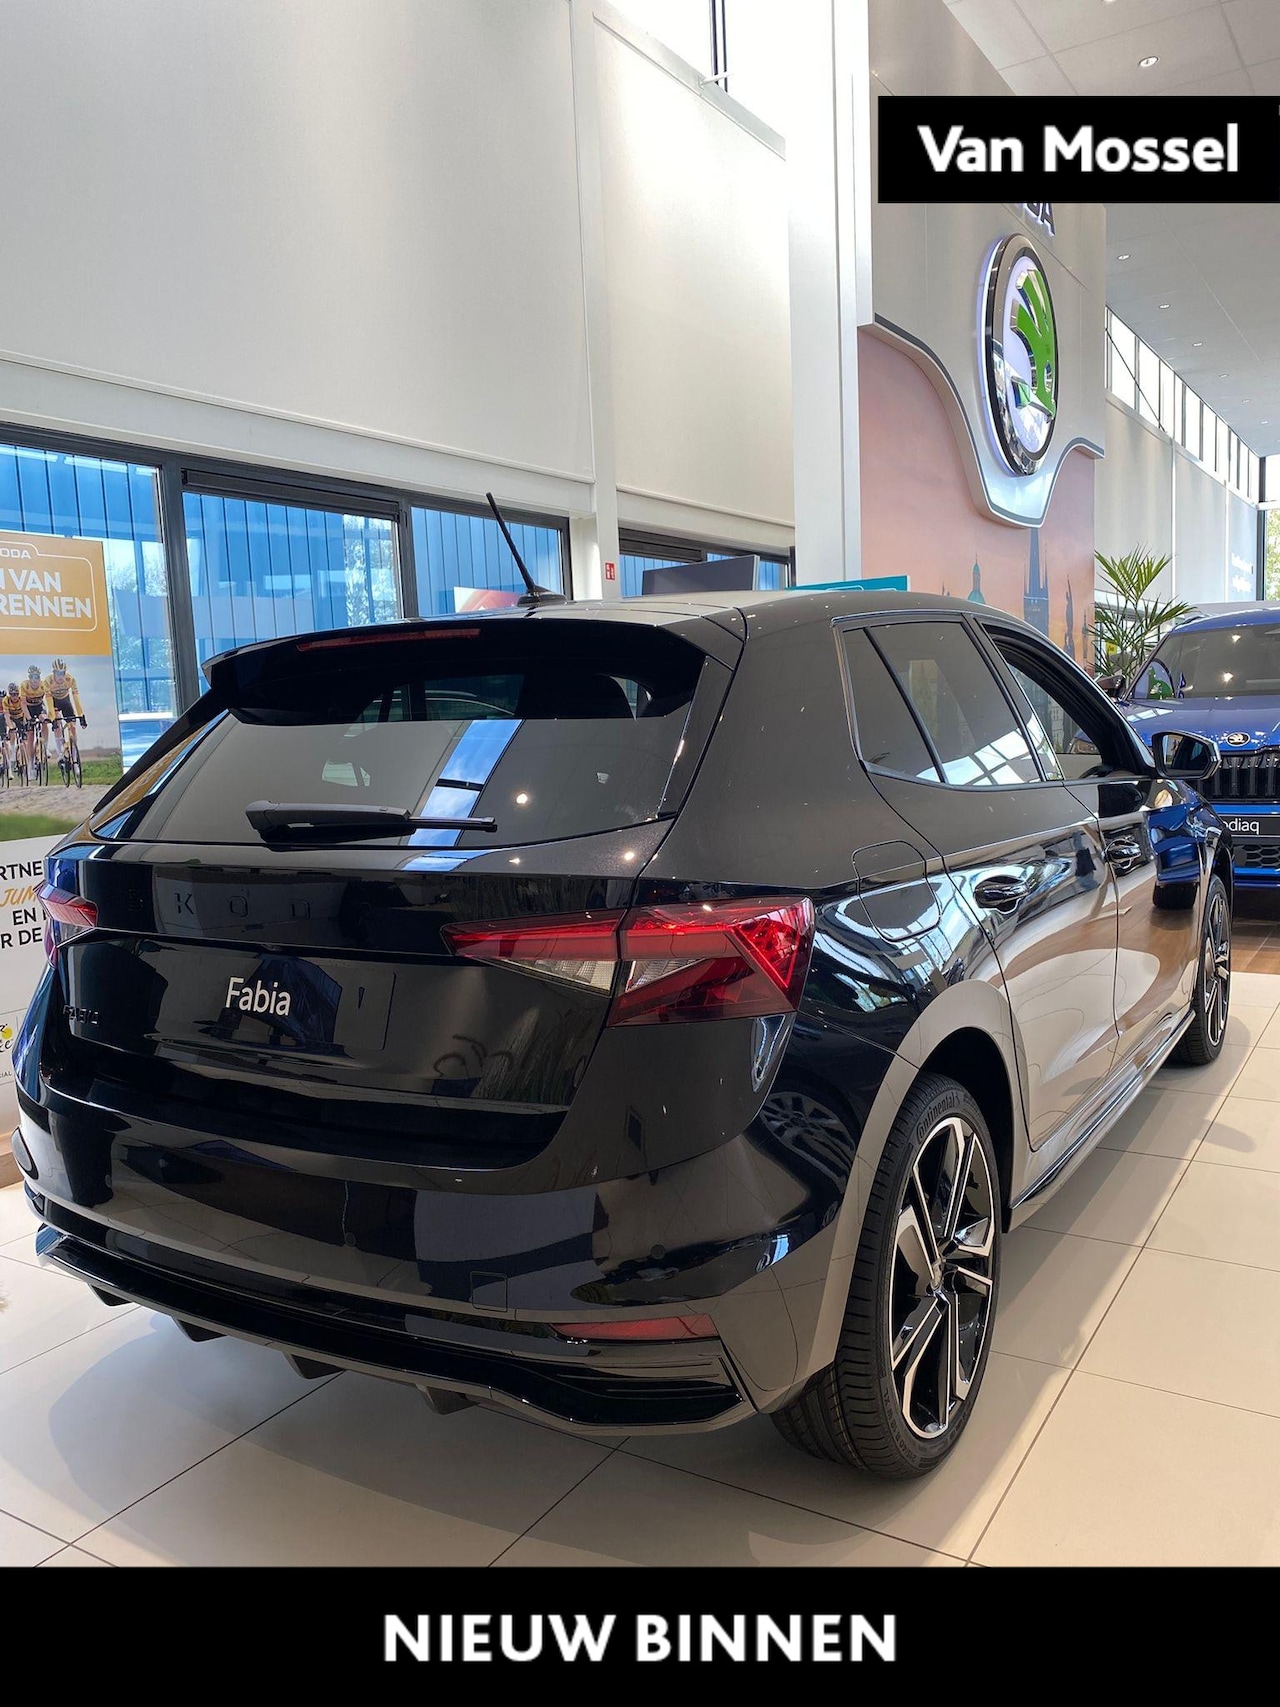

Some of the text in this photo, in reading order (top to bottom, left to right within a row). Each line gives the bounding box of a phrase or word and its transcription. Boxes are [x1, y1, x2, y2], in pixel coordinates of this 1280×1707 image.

[12, 907, 37, 926] EN
[18, 926, 43, 947] DE
[225, 975, 291, 1016] Fabia
[916, 1091, 956, 1145] Continental
